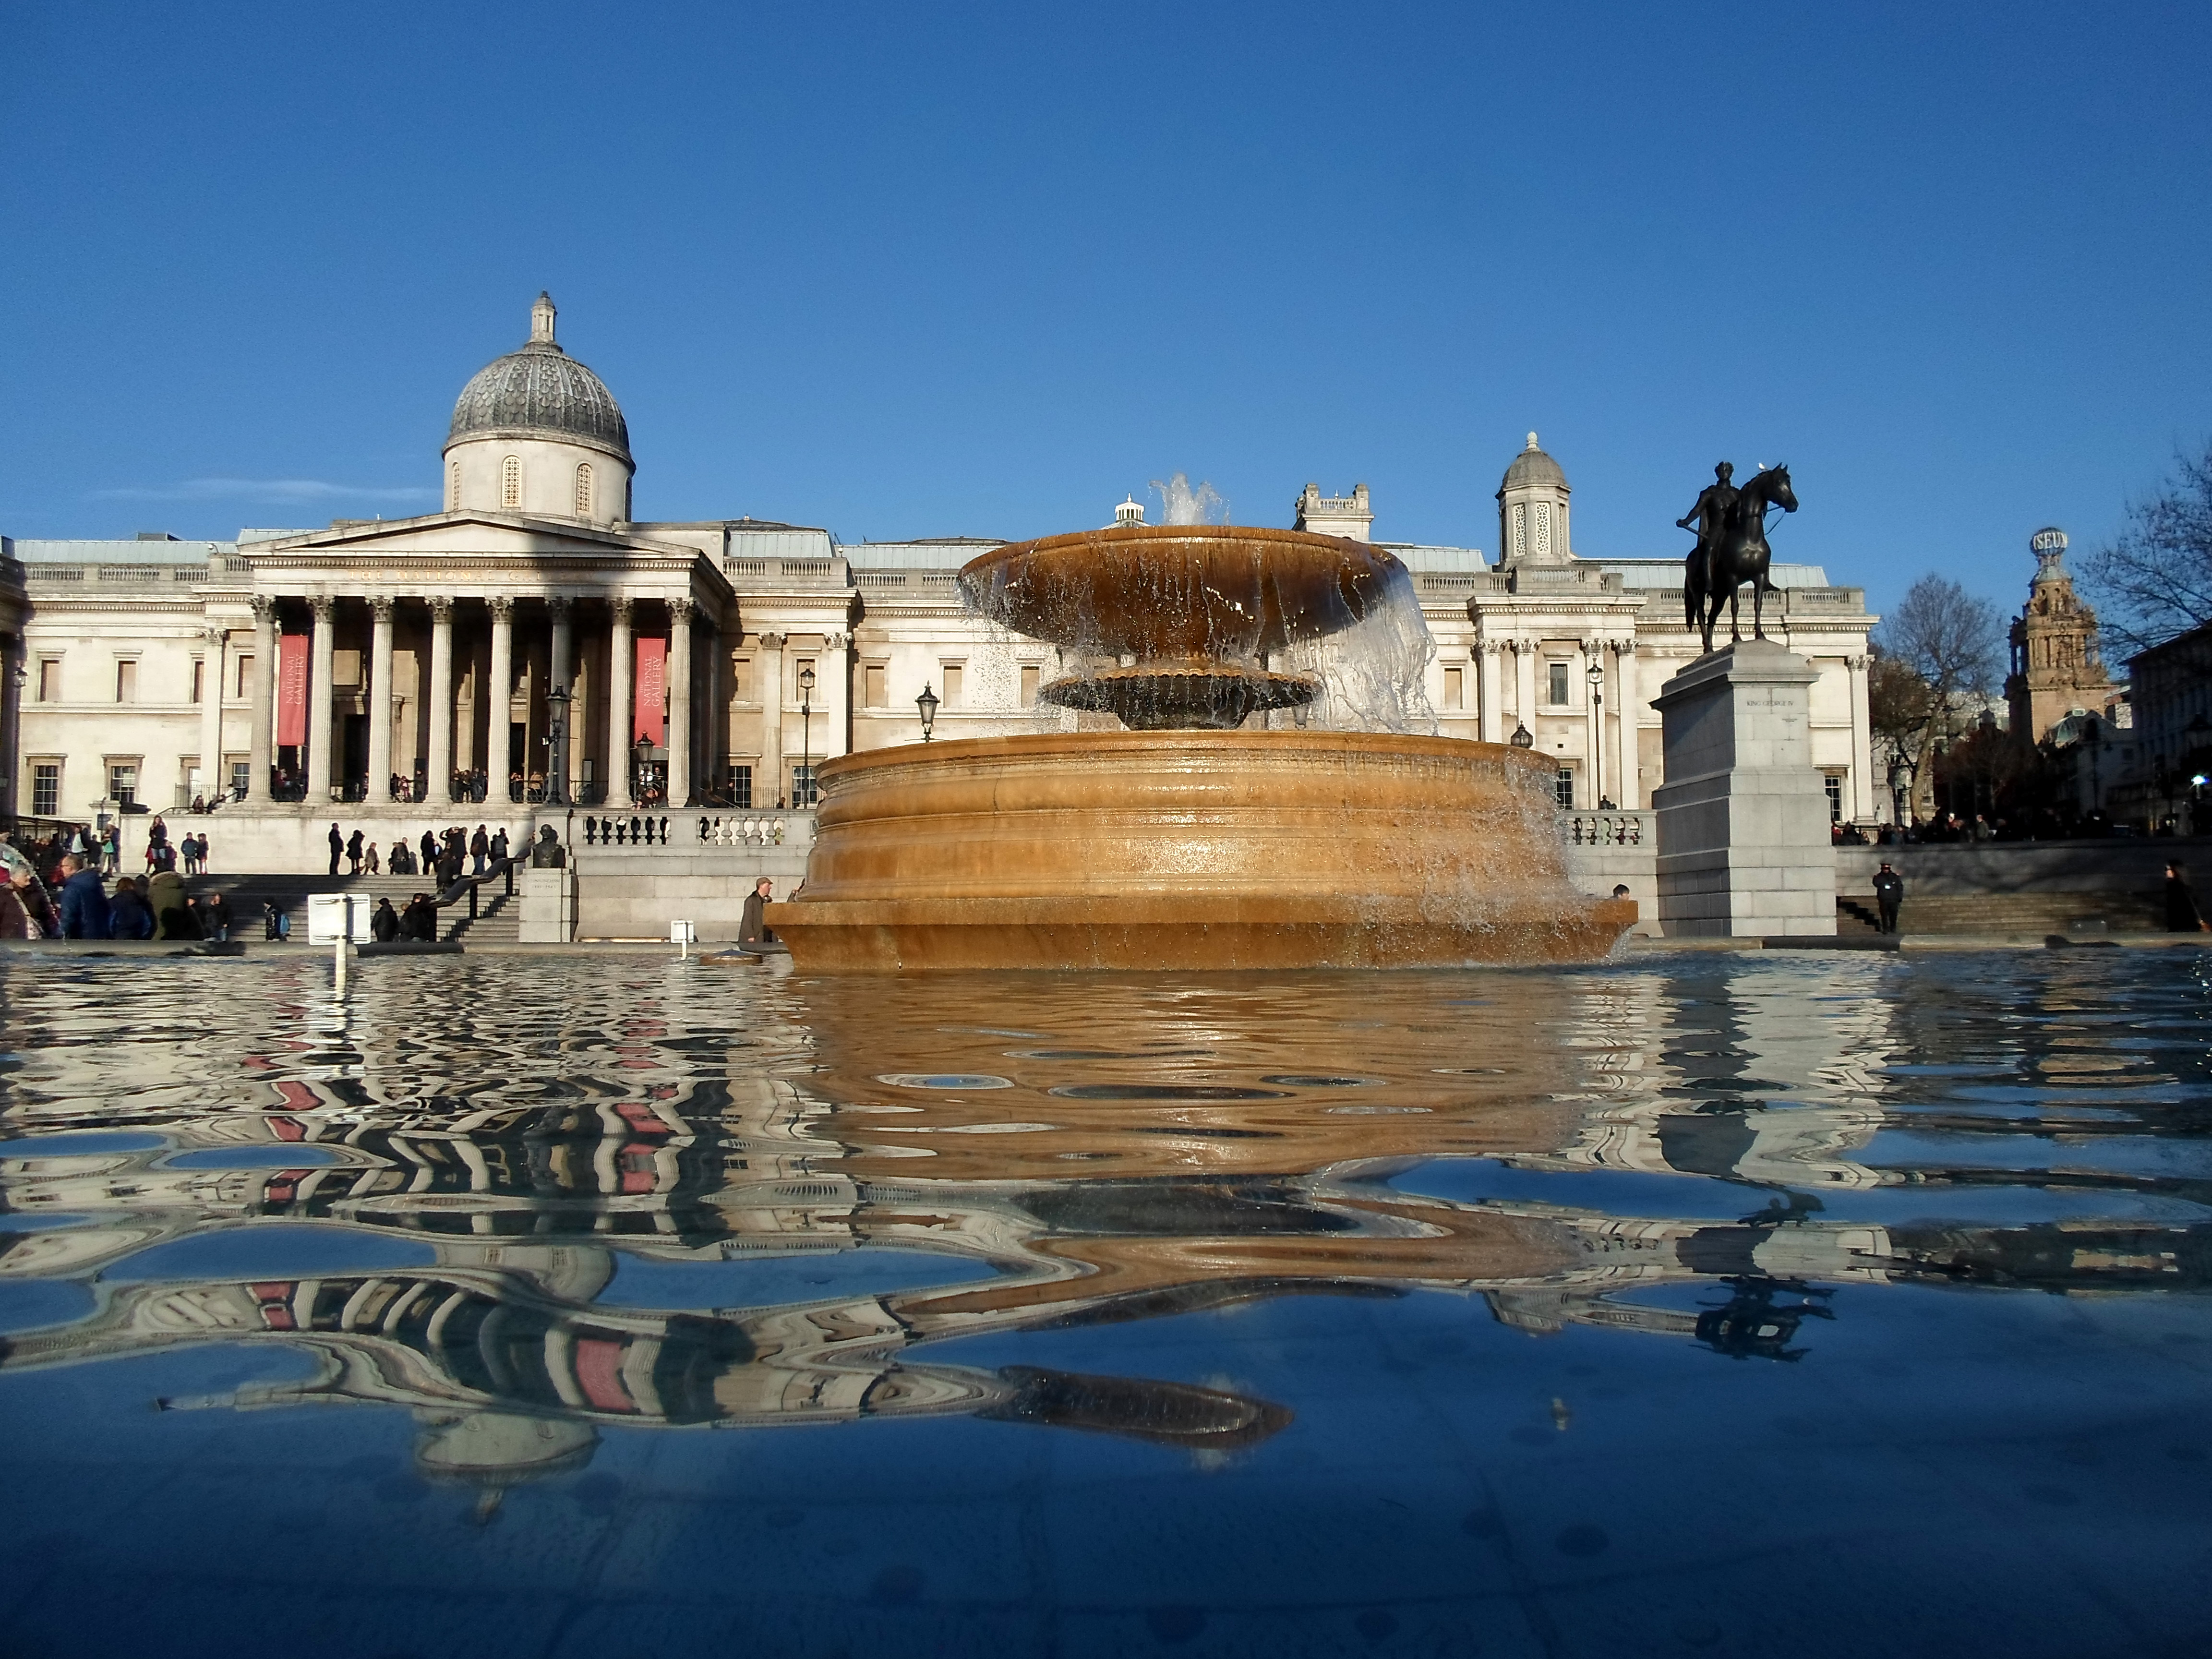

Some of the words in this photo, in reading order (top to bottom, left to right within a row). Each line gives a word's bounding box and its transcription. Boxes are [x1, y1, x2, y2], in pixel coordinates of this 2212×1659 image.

[347, 570, 383, 580] THE
[397, 570, 495, 581] NATIONAL
[286, 656, 294, 704] NATIONAL
[294, 654, 304, 705] GALLERY
[643, 655, 652, 706] NATIONAL
[651, 656, 661, 707] GALLERY
